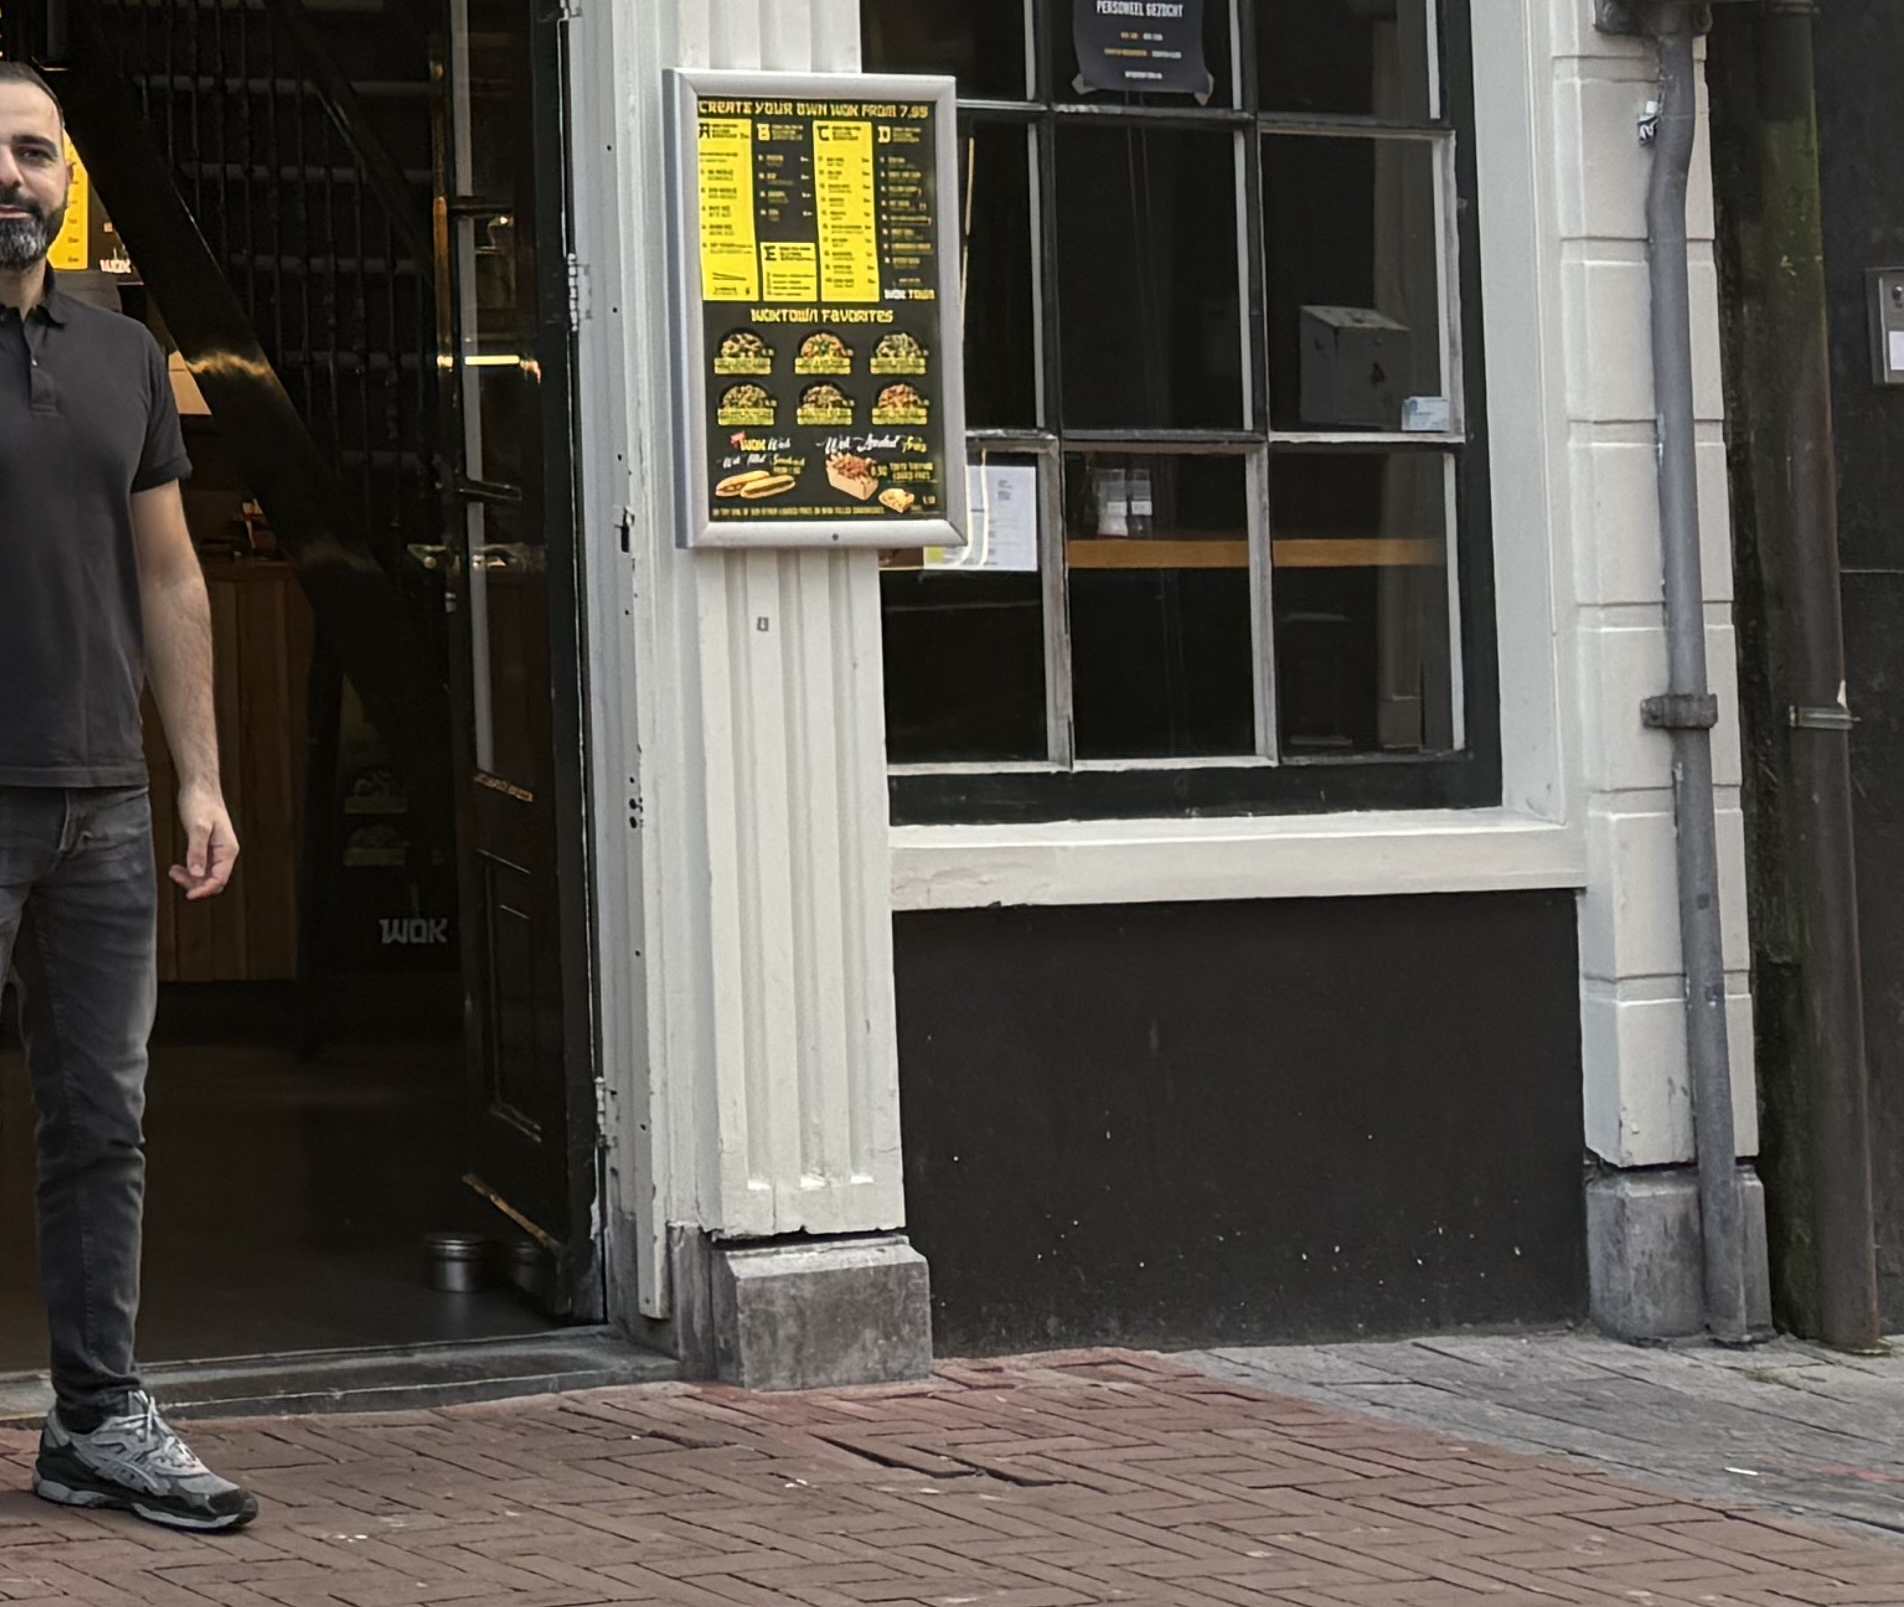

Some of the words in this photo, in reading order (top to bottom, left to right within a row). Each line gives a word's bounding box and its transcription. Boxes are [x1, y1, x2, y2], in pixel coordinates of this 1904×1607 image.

[1096, 0, 1144, 16] PERSONEEL
[1146, 3, 1183, 17] GEZOCHT
[699, 100, 752, 114] CREATE
[755, 102, 793, 115] YOUR
[797, 103, 827, 116] OWN
[861, 105, 896, 117] FROM
[764, 246, 776, 261] E
[380, 918, 448, 944] WOK
